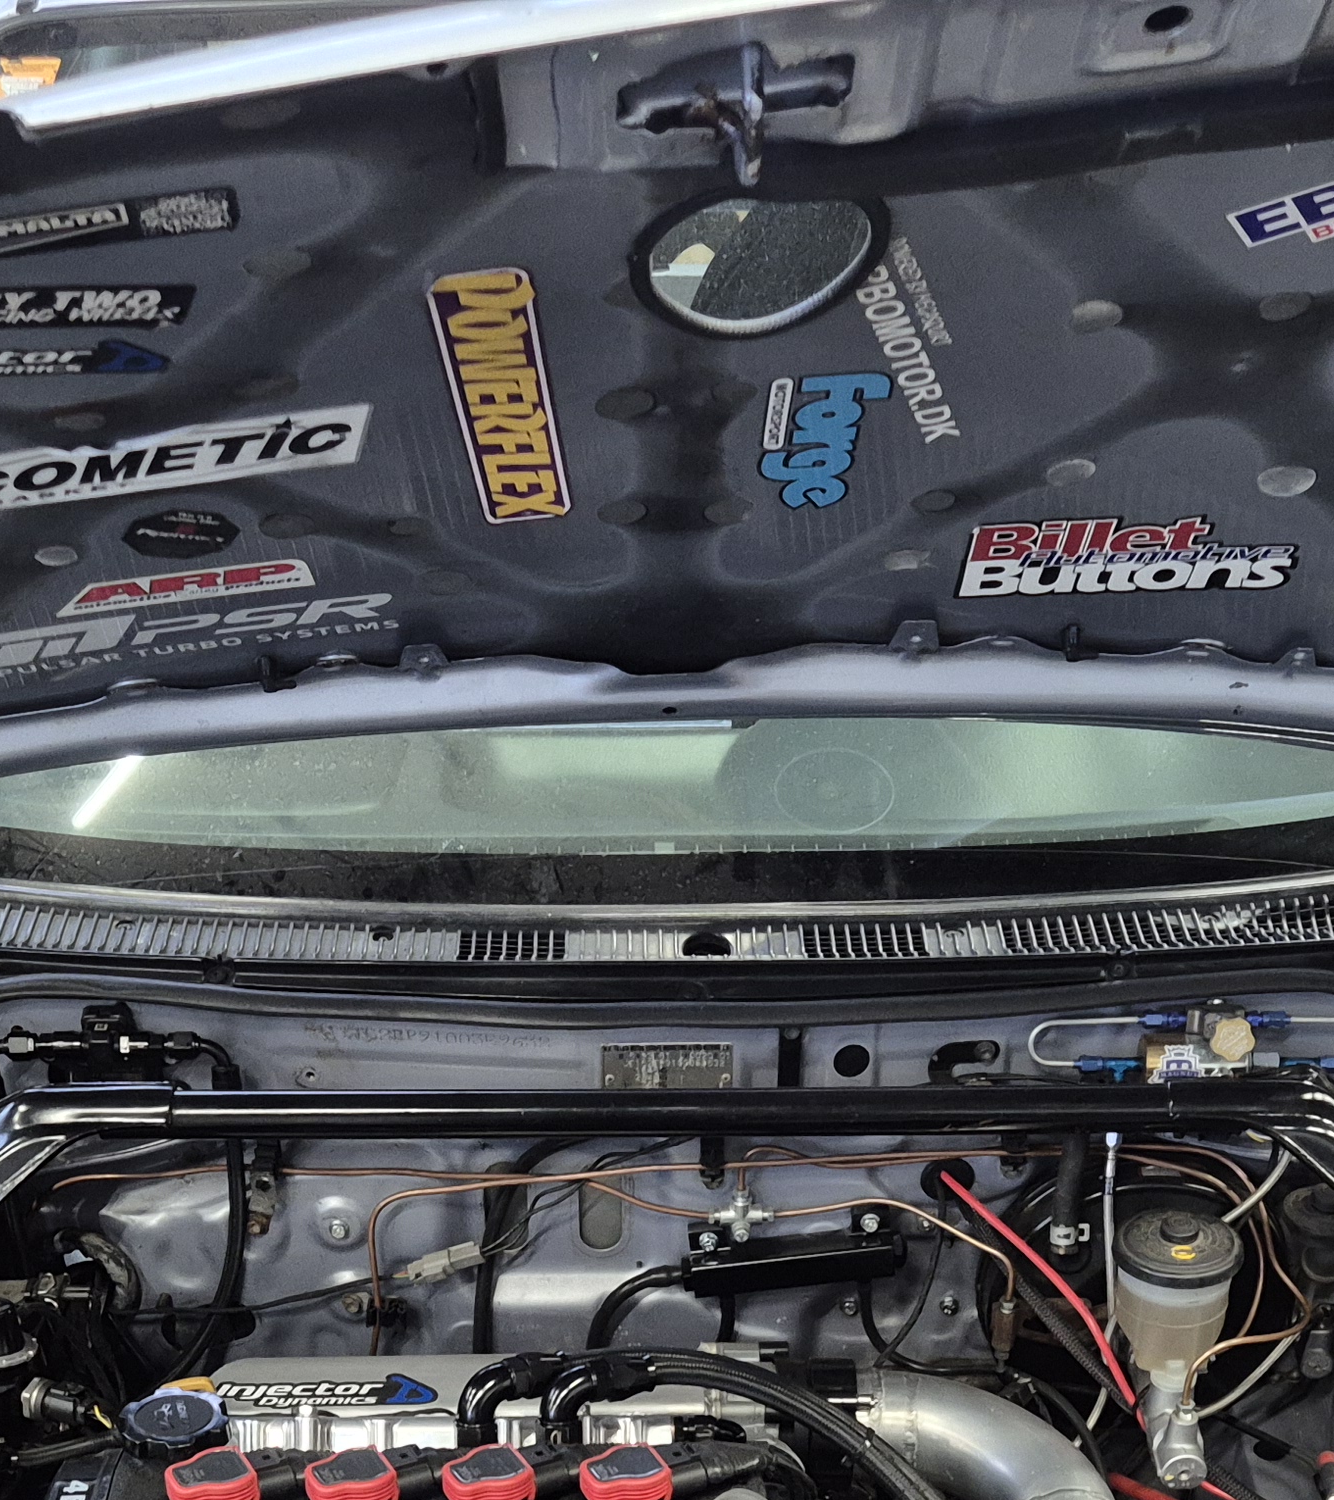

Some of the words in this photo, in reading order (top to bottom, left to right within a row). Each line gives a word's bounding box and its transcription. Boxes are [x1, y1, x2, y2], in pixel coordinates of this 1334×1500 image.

[53, 290, 163, 313] TWO
[433, 272, 565, 518] POWERFLEX
[970, 515, 1213, 564] Billet
[1017, 545, 1296, 569] Automotive
[75, 562, 299, 605] ARP
[958, 558, 1292, 598] Buttons
[131, 592, 394, 646] PSR
[136, 636, 243, 659] TURBO
[255, 618, 401, 644] SYSTEMS
[218, 1382, 385, 1400] Injector
[259, 1395, 378, 1408] Dynamics
